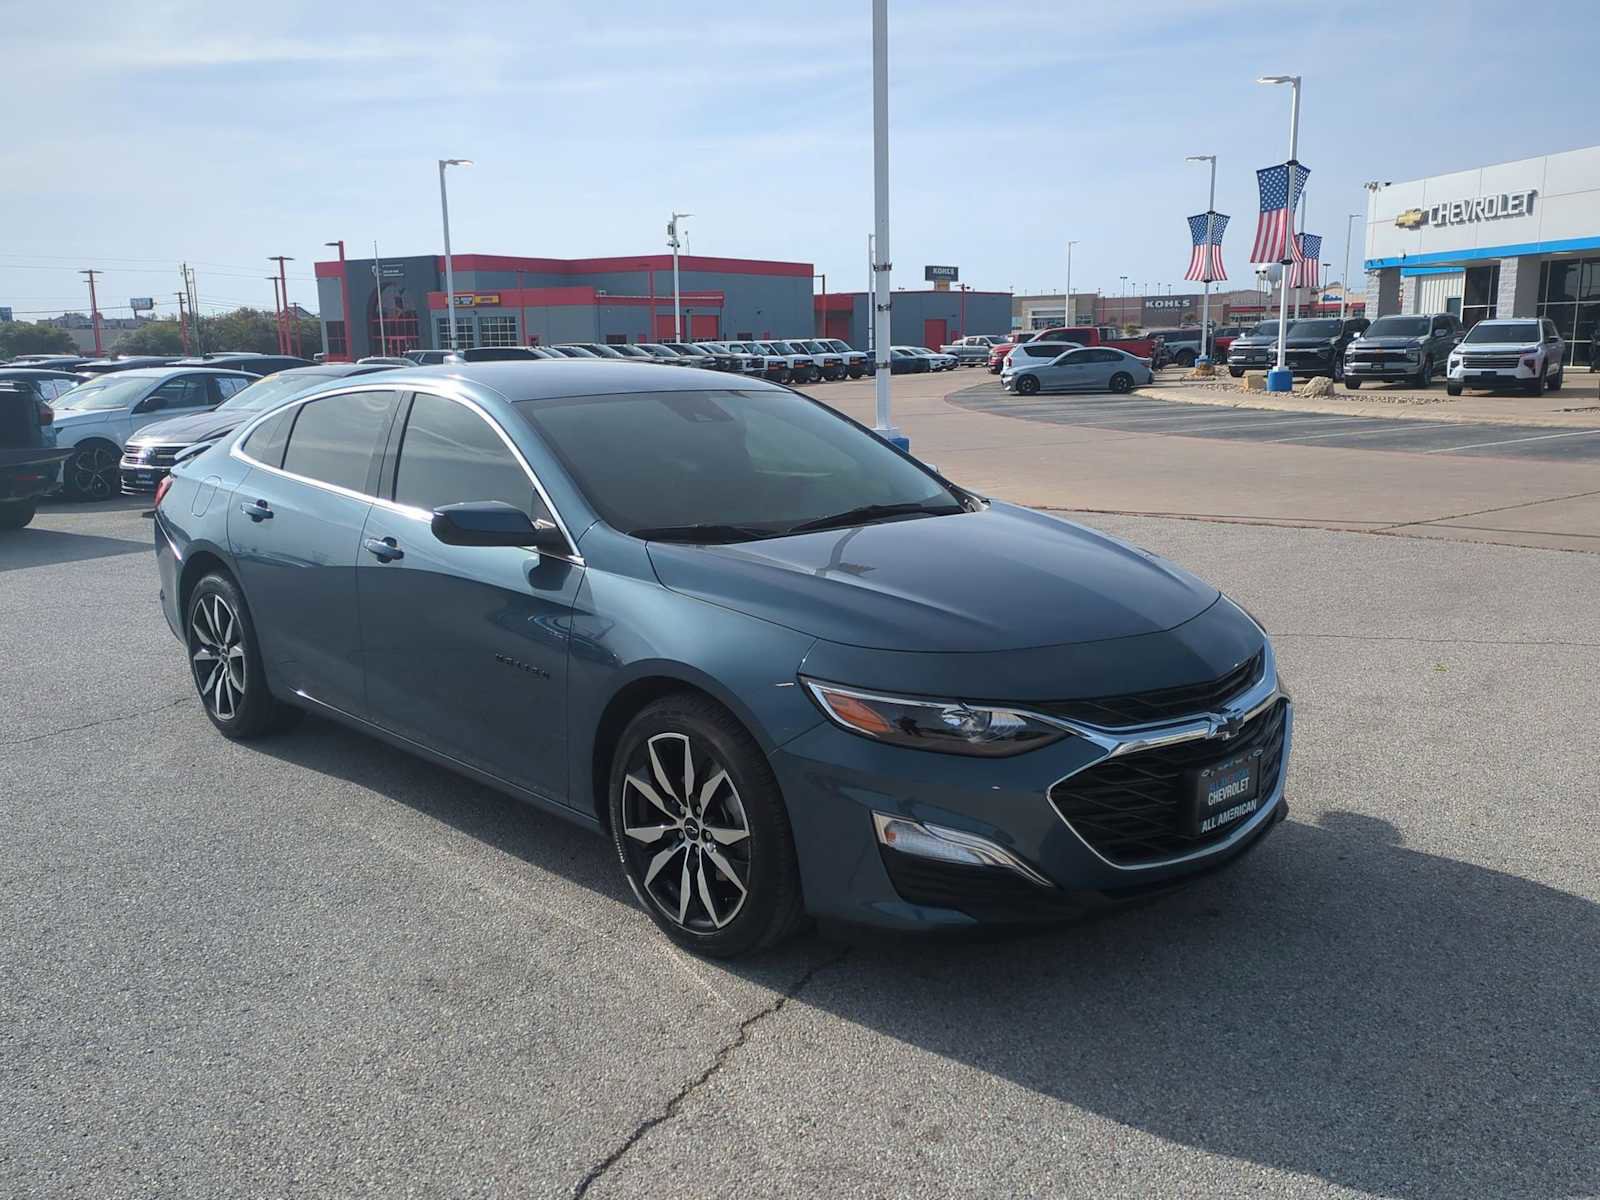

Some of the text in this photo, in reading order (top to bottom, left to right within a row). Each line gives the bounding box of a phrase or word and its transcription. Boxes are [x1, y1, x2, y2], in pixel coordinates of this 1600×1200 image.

[1428, 189, 1537, 226] CHEVROLET
[1208, 776, 1250, 806] CHEVROLET
[1201, 799, 1257, 833] ALL AMERICAN
